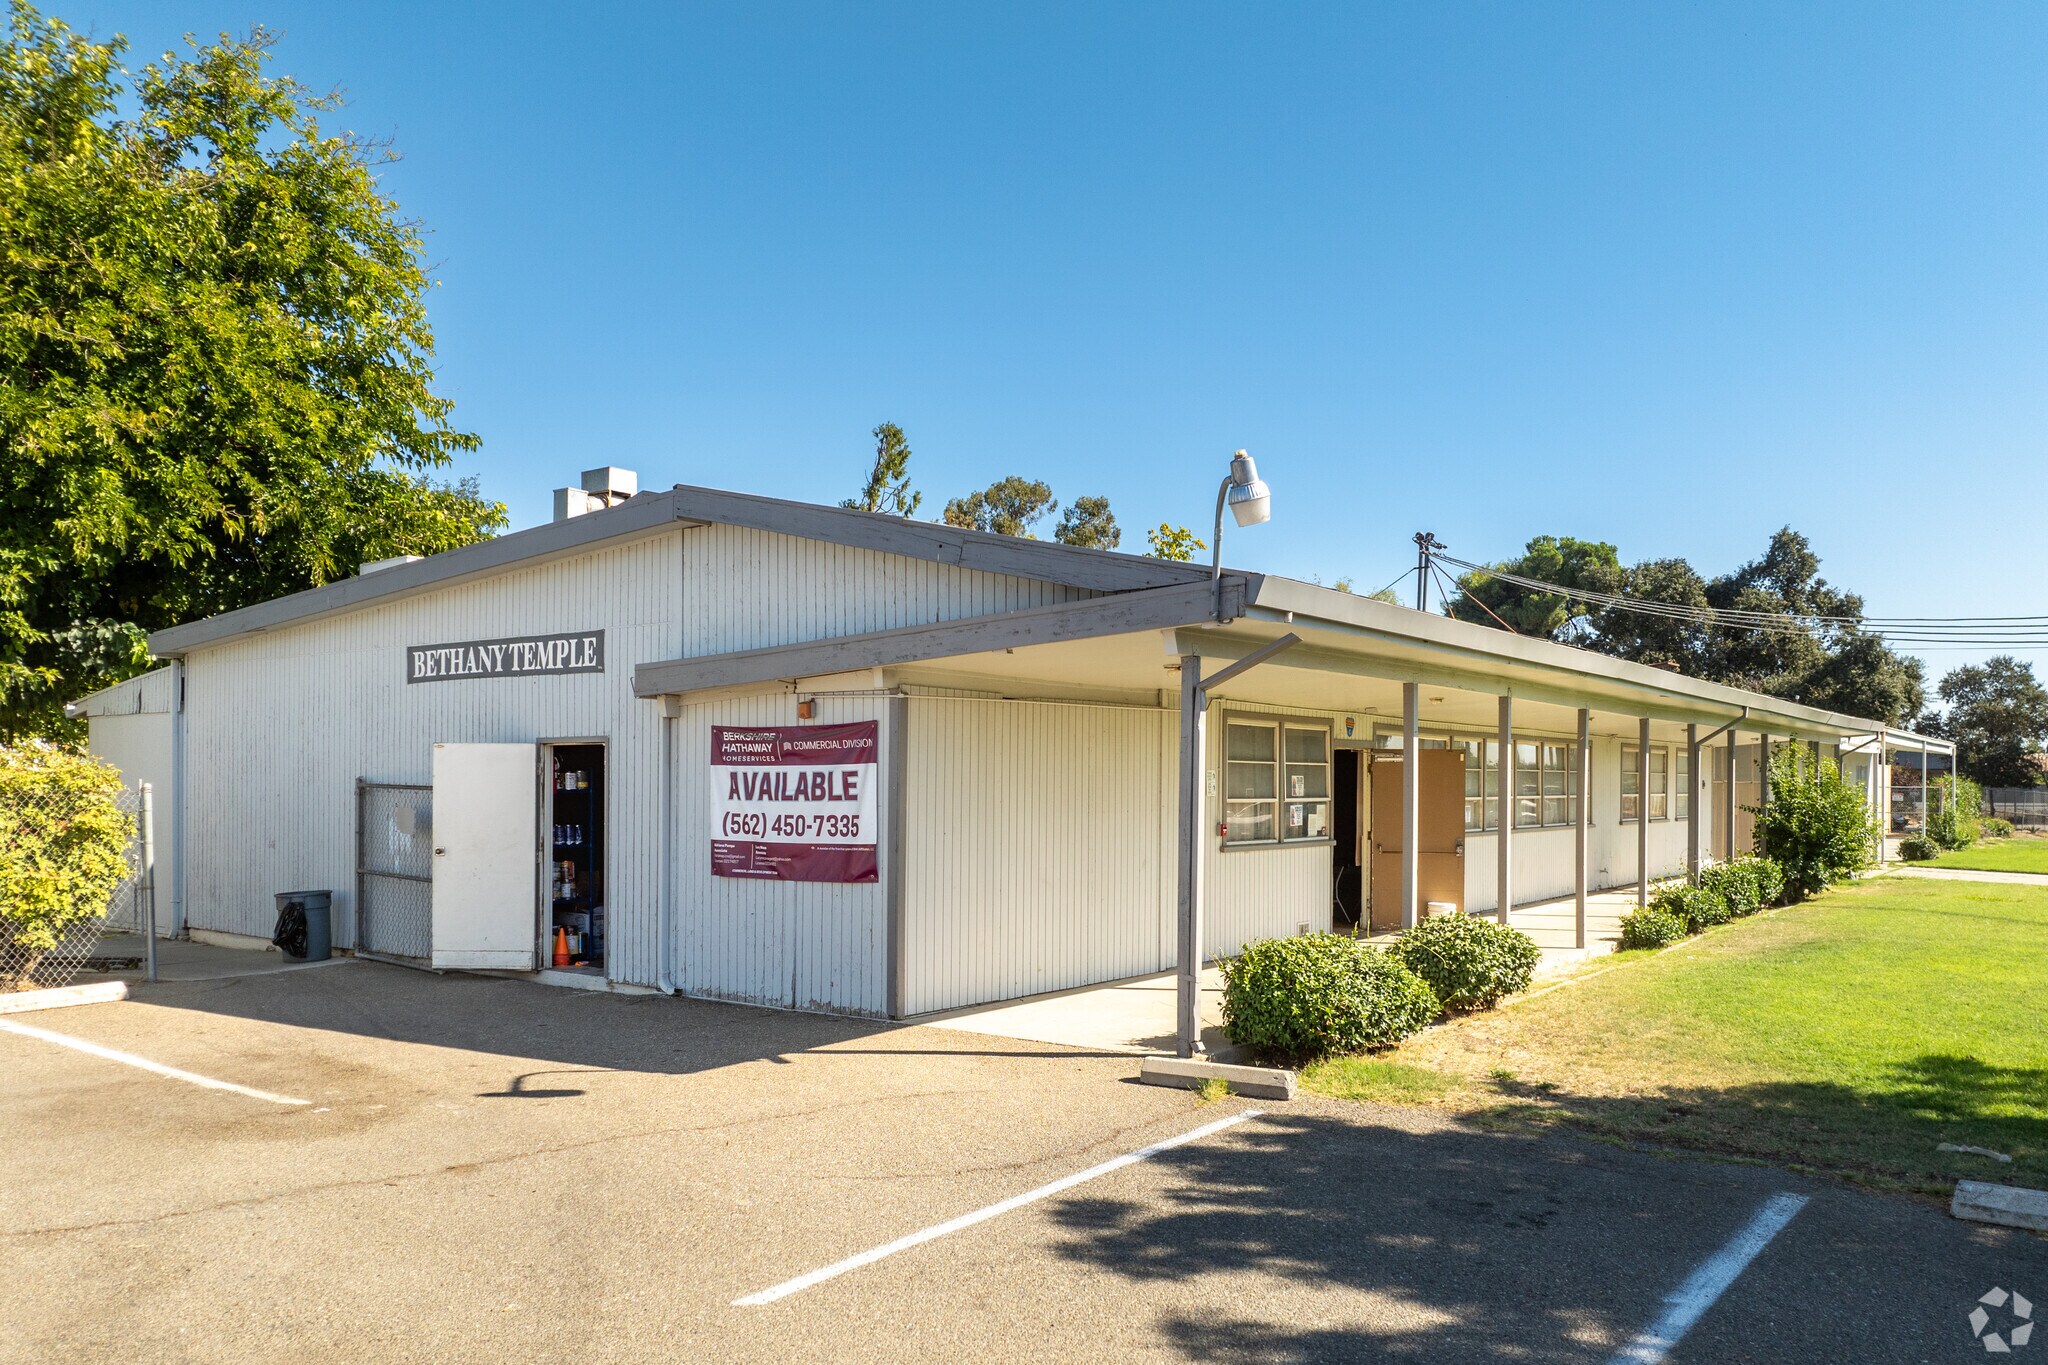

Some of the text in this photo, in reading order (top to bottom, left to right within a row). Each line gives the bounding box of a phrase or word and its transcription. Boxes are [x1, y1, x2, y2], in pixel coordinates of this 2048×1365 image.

[412, 637, 597, 678] BETHANY TEMPLE
[723, 731, 776, 741] BERKSHIRE
[793, 738, 873, 750] COMMERCIAL DIVISION
[721, 743, 772, 753] HATHAWAY
[728, 771, 859, 801] AVAILABLE
[722, 811, 860, 838] (562) 450-7335
